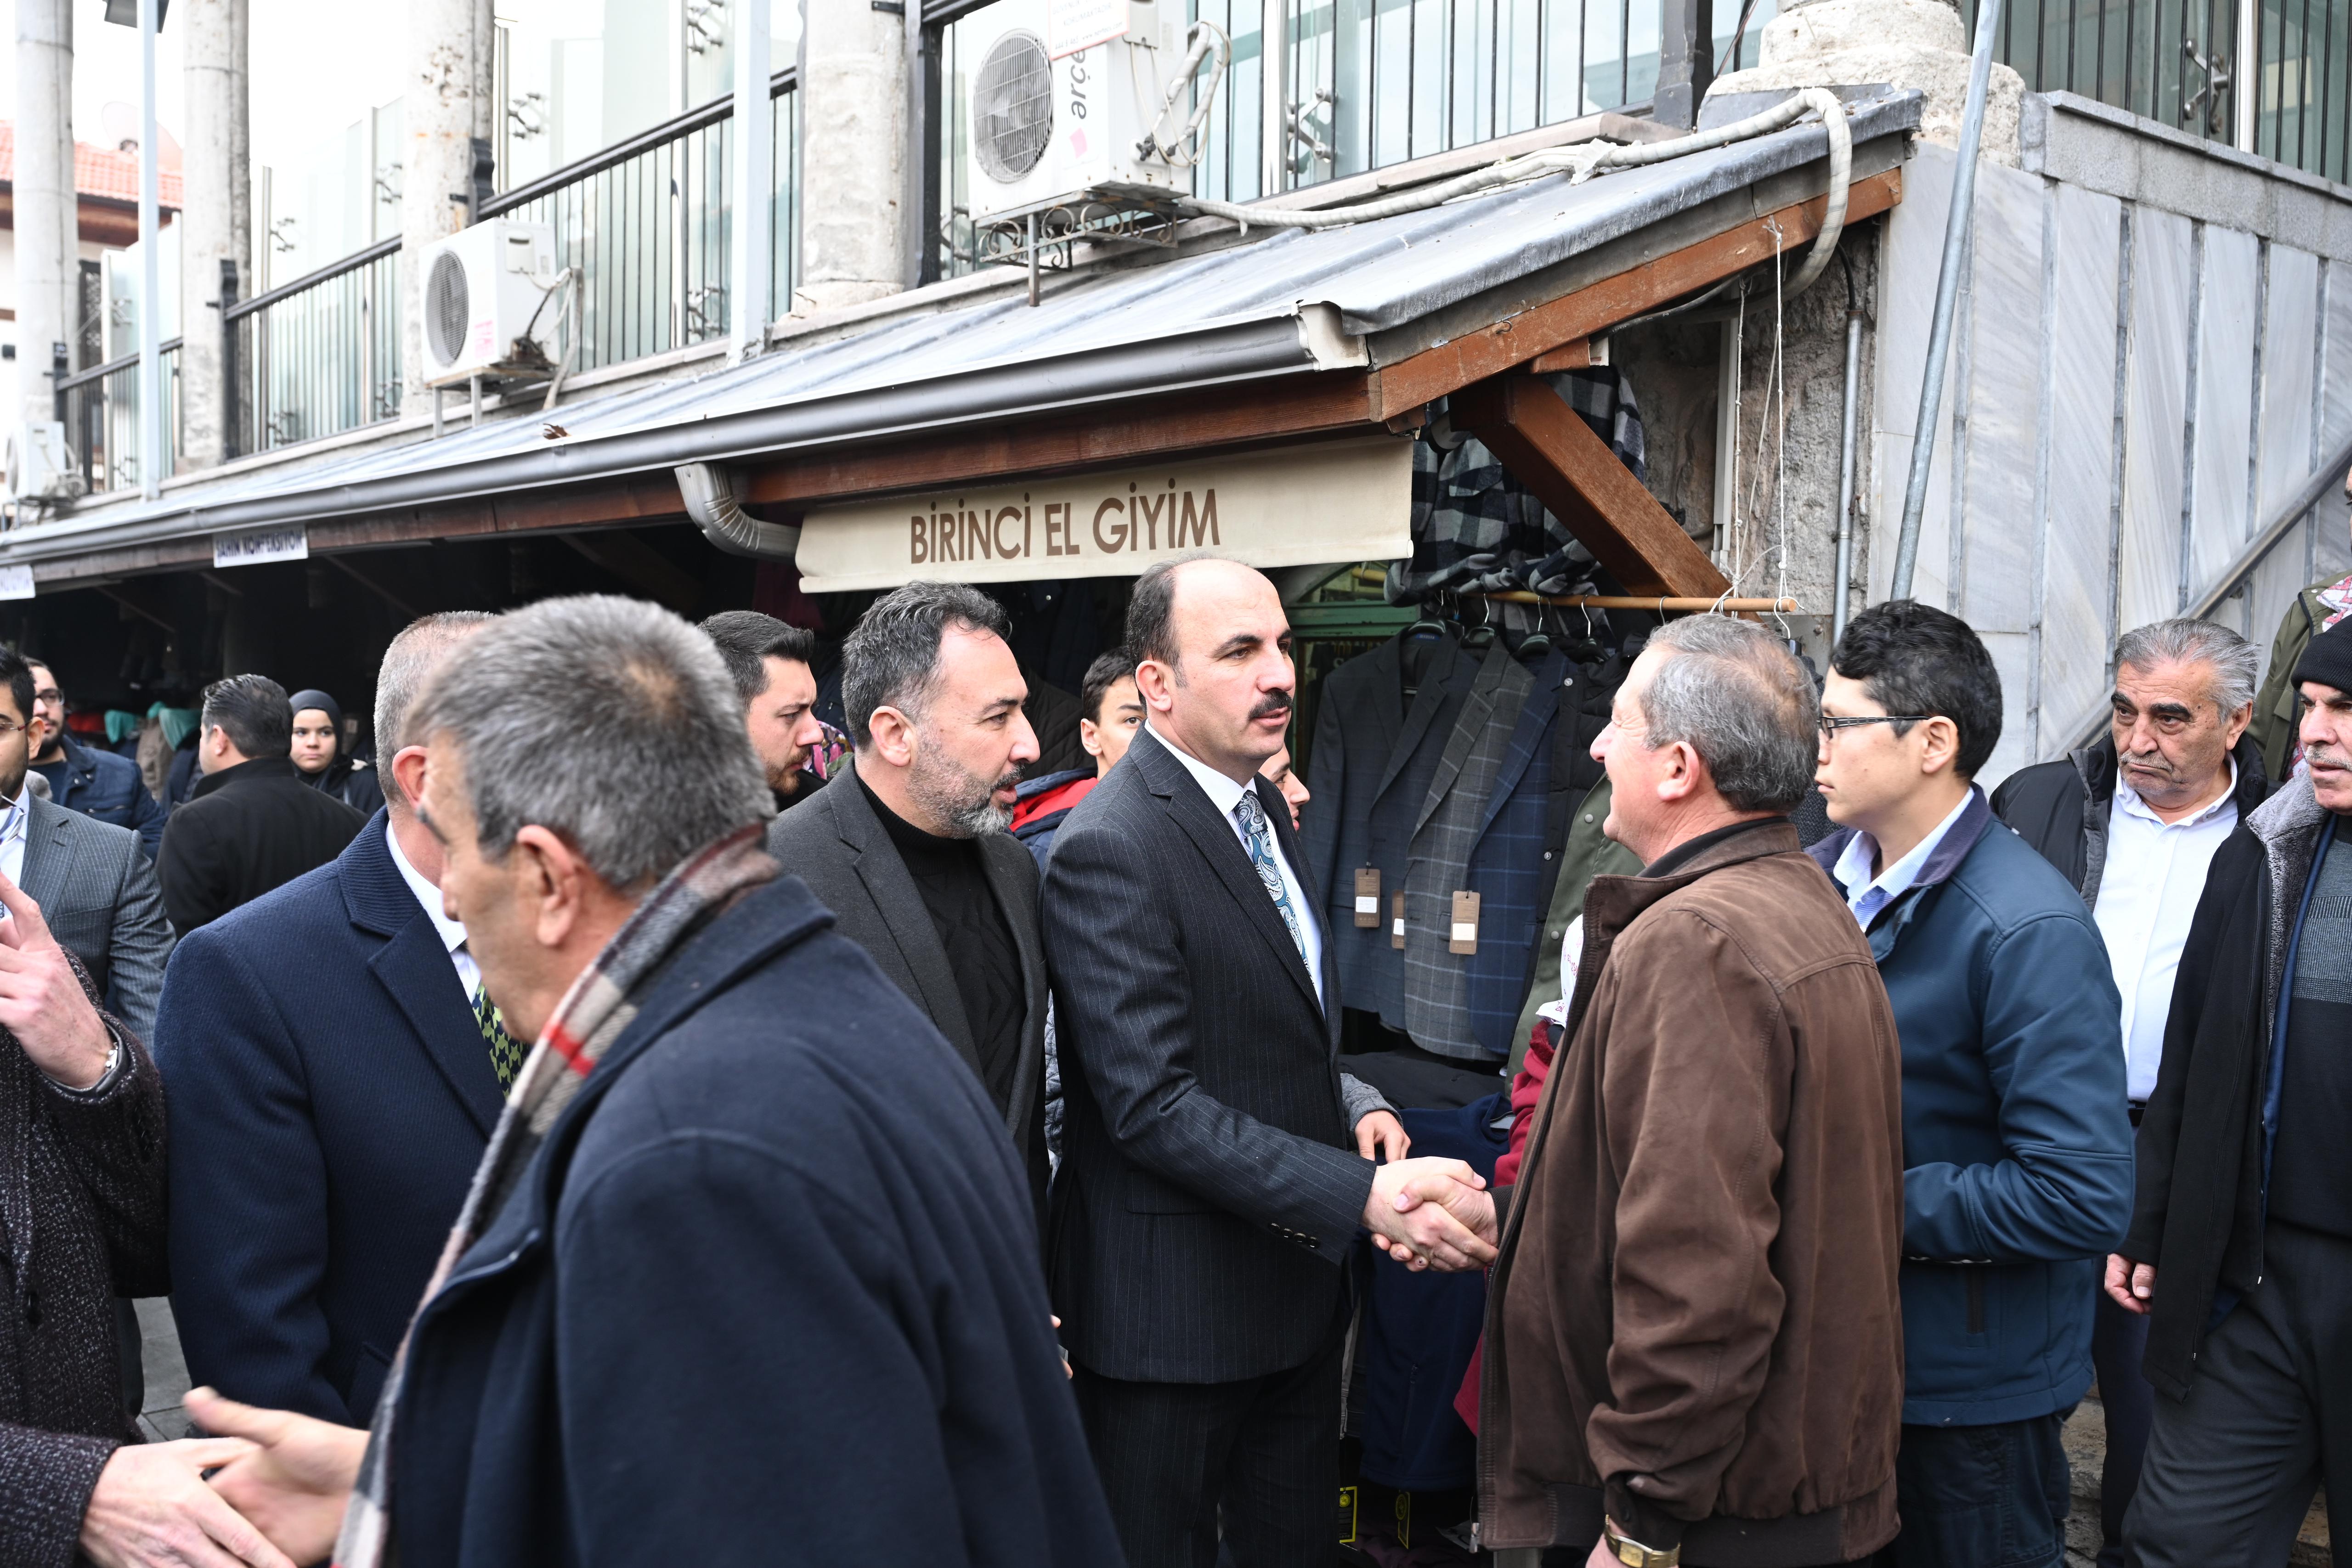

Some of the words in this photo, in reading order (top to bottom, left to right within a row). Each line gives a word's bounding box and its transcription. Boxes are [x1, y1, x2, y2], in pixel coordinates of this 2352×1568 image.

[910, 491, 1031, 564] BİRİNCİ
[1044, 502, 1080, 557] EL
[1092, 477, 1221, 554] GİYİM
